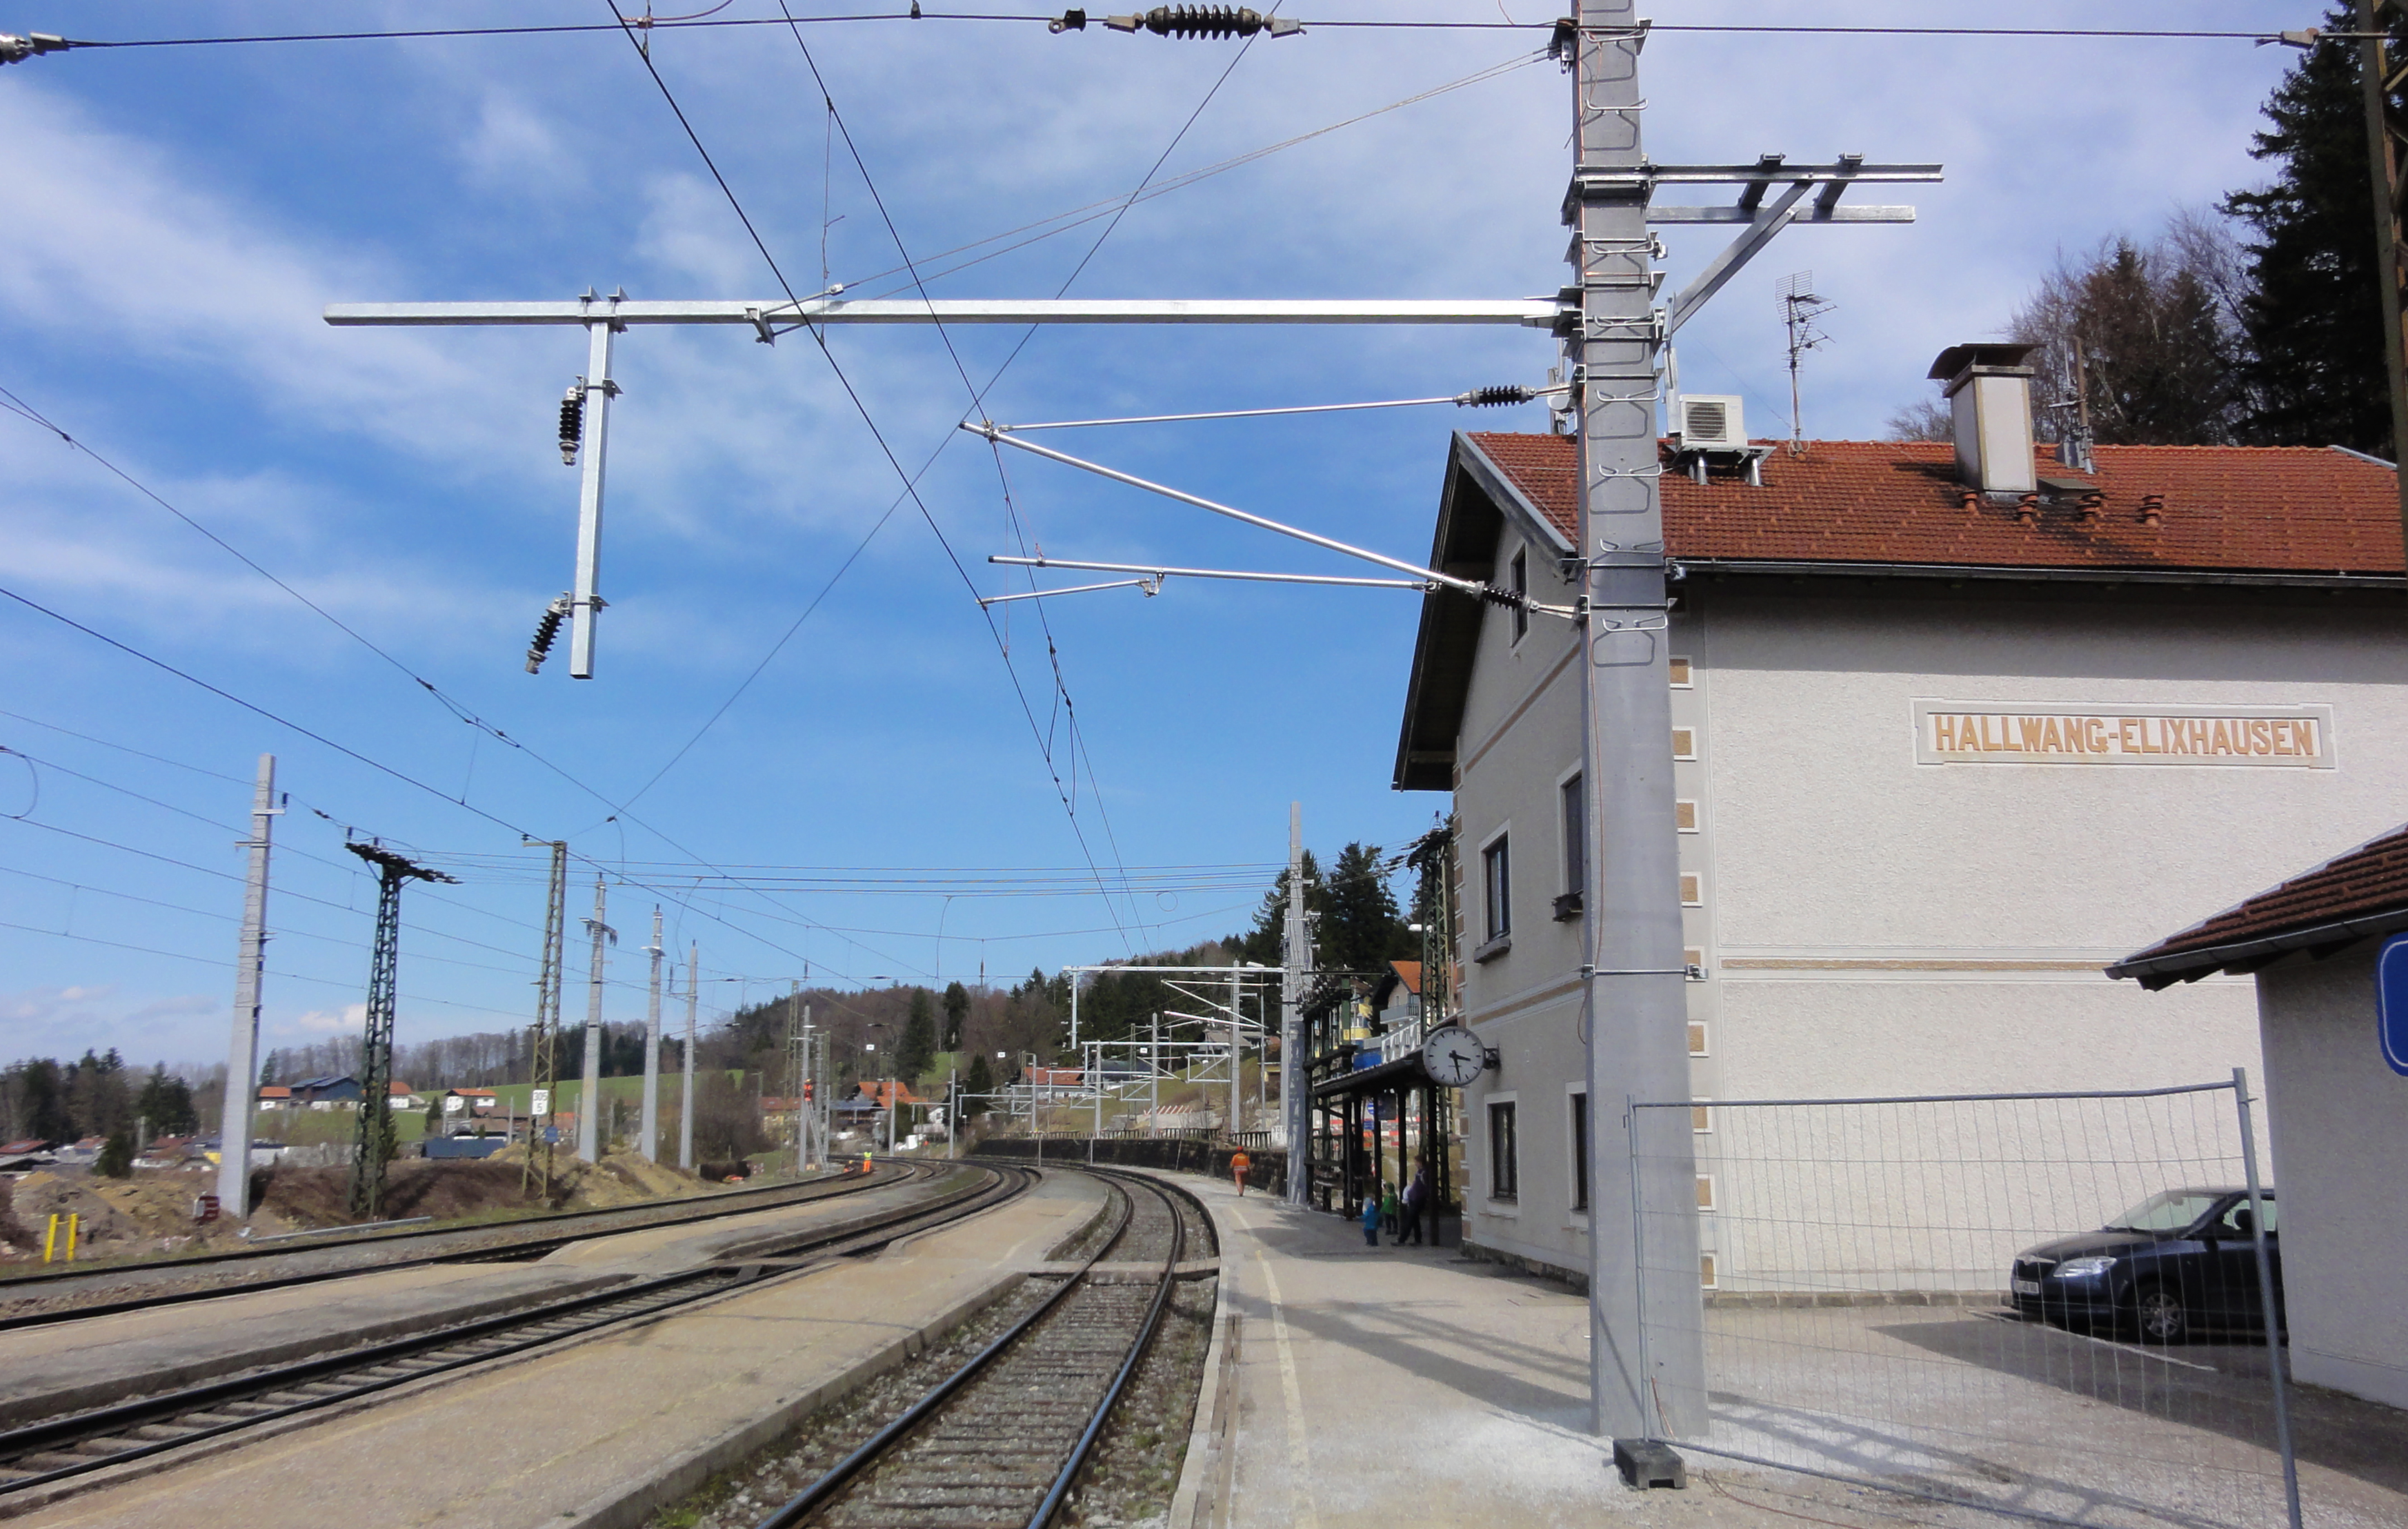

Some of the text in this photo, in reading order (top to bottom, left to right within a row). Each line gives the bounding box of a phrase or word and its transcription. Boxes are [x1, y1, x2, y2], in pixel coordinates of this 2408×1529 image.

[1934, 715, 2314, 756] HALLWANG-ELIXHAUSEN
[533, 1092, 548, 1101] 305
[537, 1103, 543, 1112] 5
